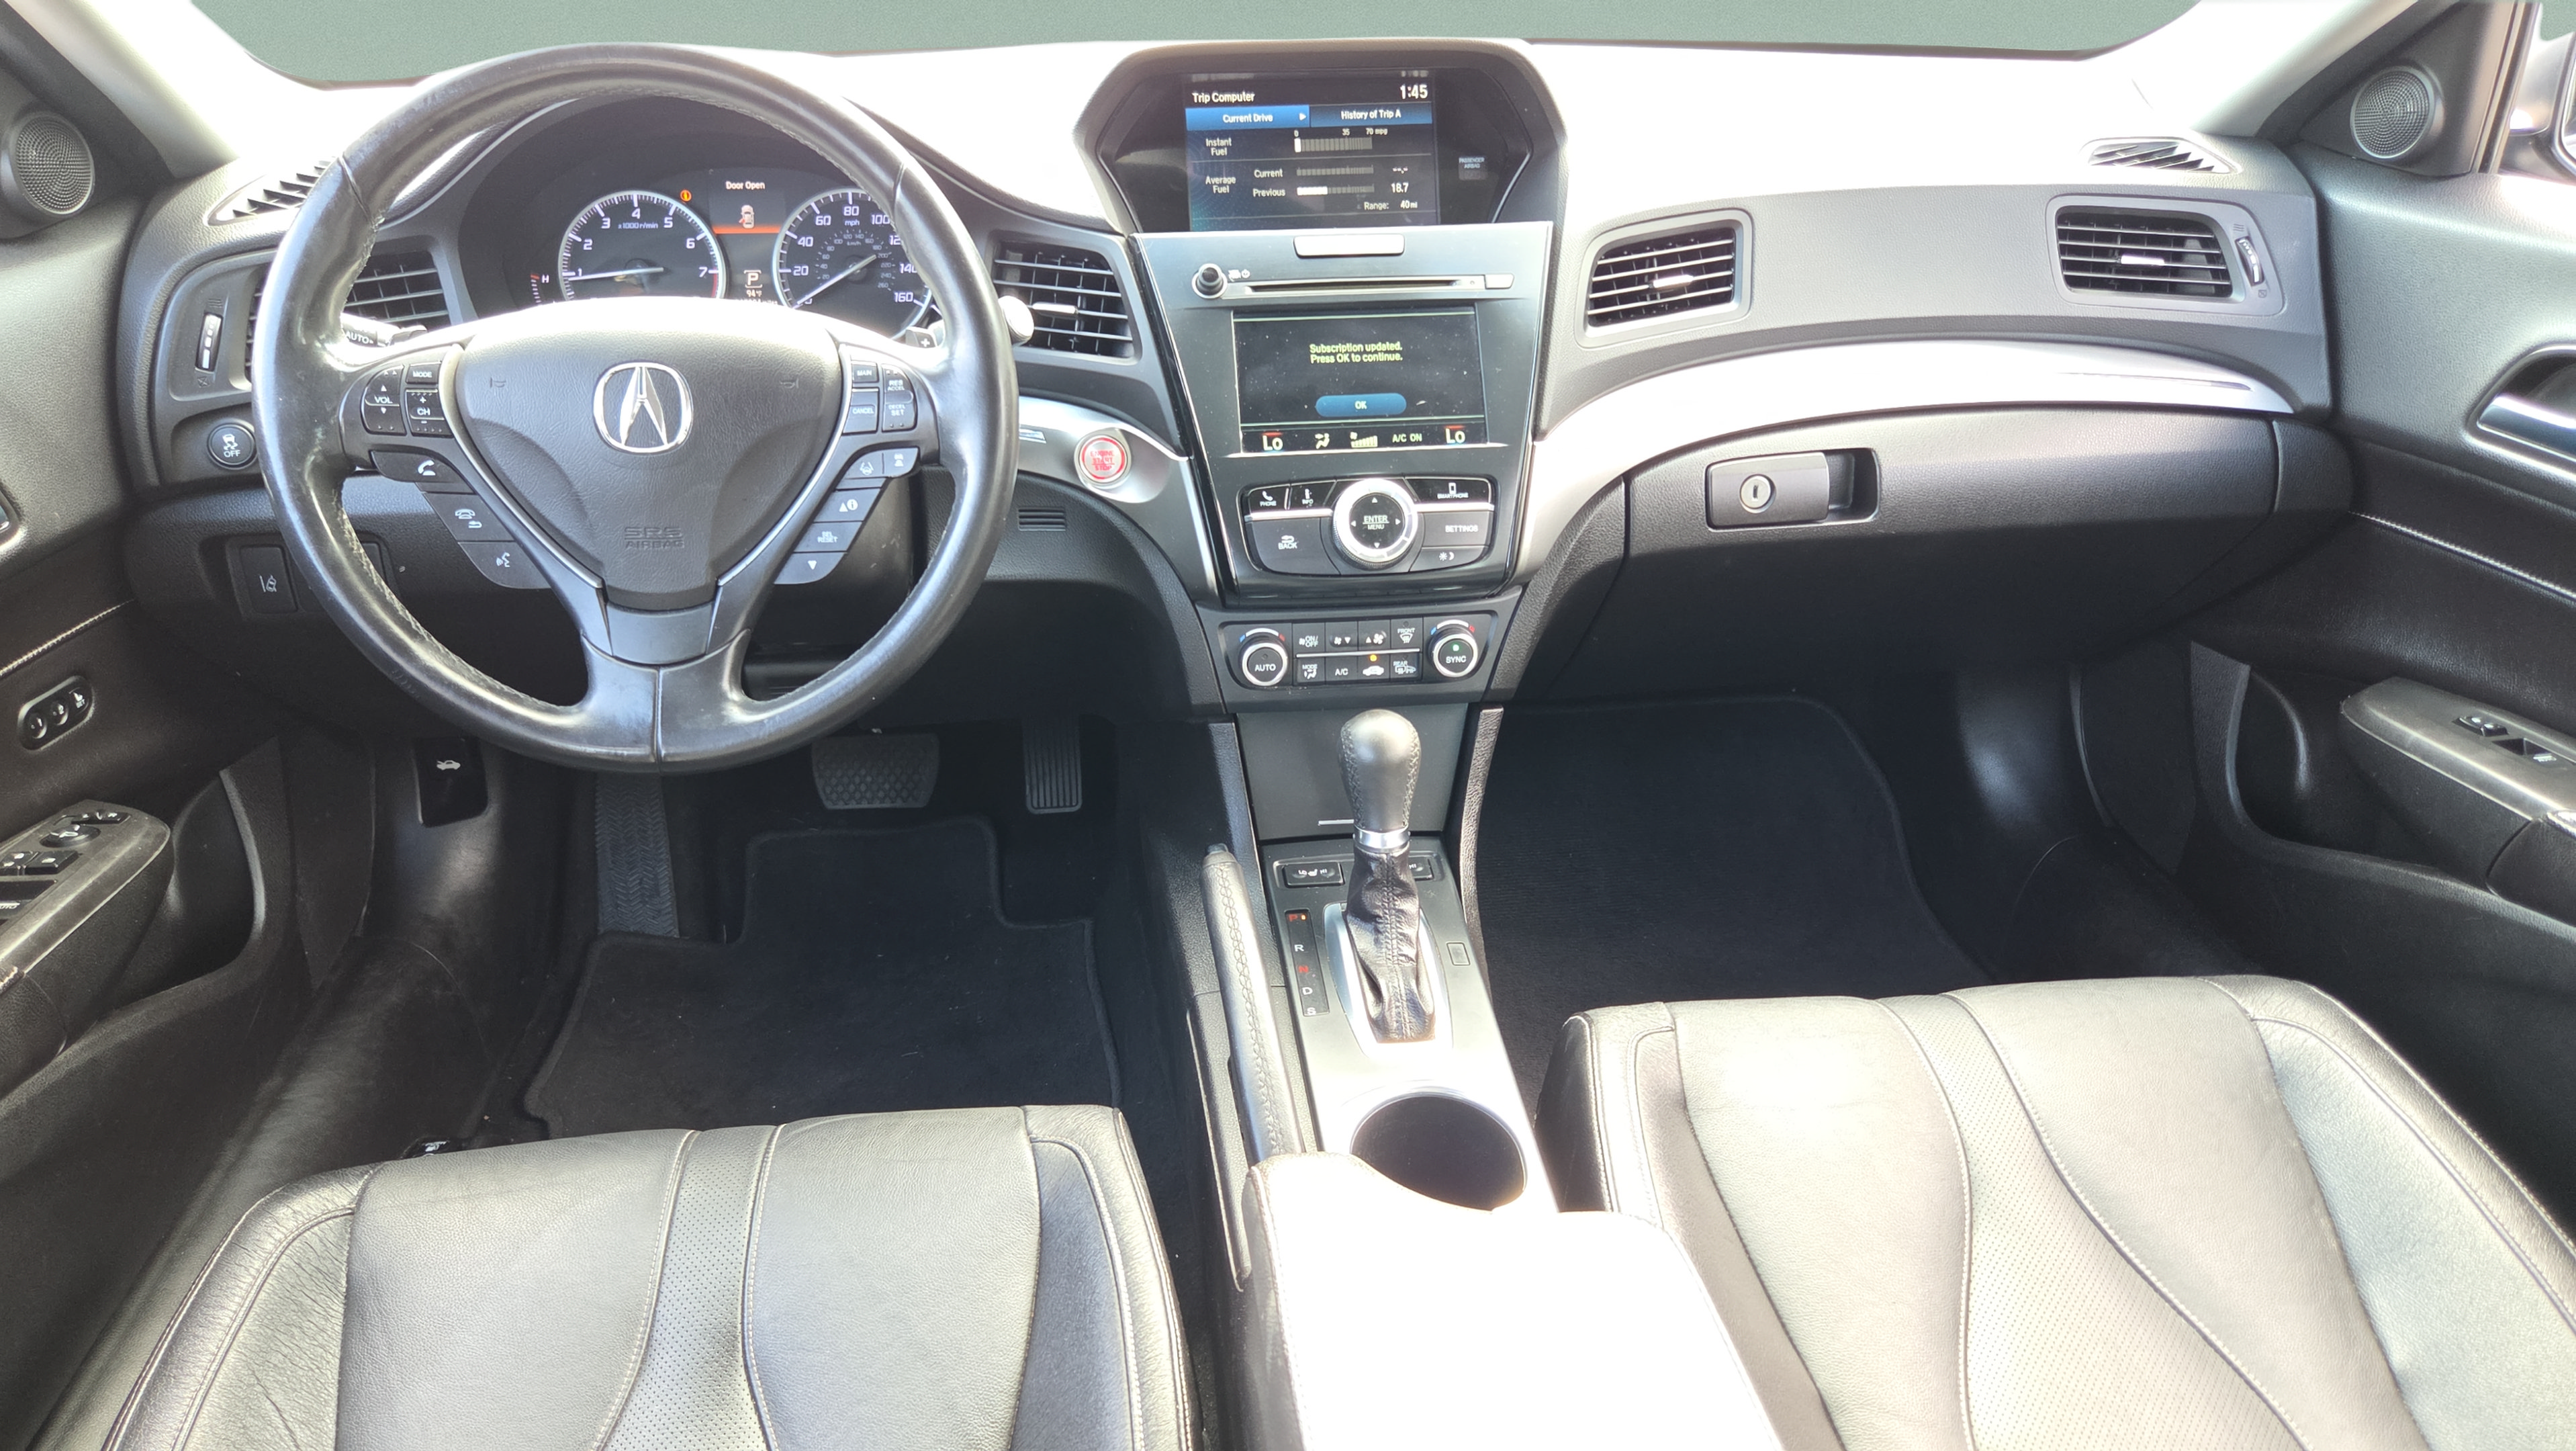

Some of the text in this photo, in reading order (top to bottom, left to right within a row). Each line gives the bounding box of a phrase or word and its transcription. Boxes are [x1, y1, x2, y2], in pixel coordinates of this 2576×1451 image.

[1400, 84, 1428, 99] 1:45
[1192, 91, 1255, 103] Trip Computer
[1222, 114, 1273, 123] Current Drive
[1341, 109, 1401, 120] History of Trip A
[1205, 138, 1232, 146] Instant
[1211, 147, 1228, 156] Fuel
[1254, 169, 1283, 178] Current
[1205, 175, 1236, 185] Average
[725, 181, 766, 190] Door Open
[1213, 185, 1230, 193] Fuel
[1391, 183, 1409, 193] 18.7
[1252, 188, 1286, 197] Previous
[1364, 201, 1389, 210] Range:
[631, 208, 641, 219] 4
[843, 206, 860, 216] 80
[601, 218, 610, 229] 3
[663, 217, 673, 228] 5
[815, 216, 831, 226] 60
[871, 214, 890, 224] 100
[583, 238, 593, 251] 2
[686, 238, 695, 249] 6
[797, 236, 813, 247] 40
[578, 268, 583, 277] 1
[699, 267, 708, 277] 7
[793, 265, 809, 276] 20
[541, 275, 549, 283] H
[747, 272, 759, 285] P
[894, 292, 913, 302] 160
[345, 331, 370, 345] AUTO
[1309, 341, 1403, 353] Subscription updated.
[1310, 352, 1404, 363] Press OK to continue.
[374, 395, 393, 404] VOL
[1354, 400, 1367, 409] OK
[417, 407, 430, 415] CH
[1392, 433, 1422, 443] A/C ON
[1445, 429, 1466, 444] Lo
[1262, 435, 1283, 451] Lo
[224, 449, 240, 457] OFF
[1363, 515, 1388, 523] ENTER
[625, 527, 683, 538] SRS
[1445, 525, 1479, 533] SETTINGS
[625, 539, 685, 549] AIRBAG
[1446, 656, 1467, 664] SYNC
[1254, 664, 1276, 672] AUTO
[1289, 914, 1298, 922] P
[1302, 987, 1313, 996] D
